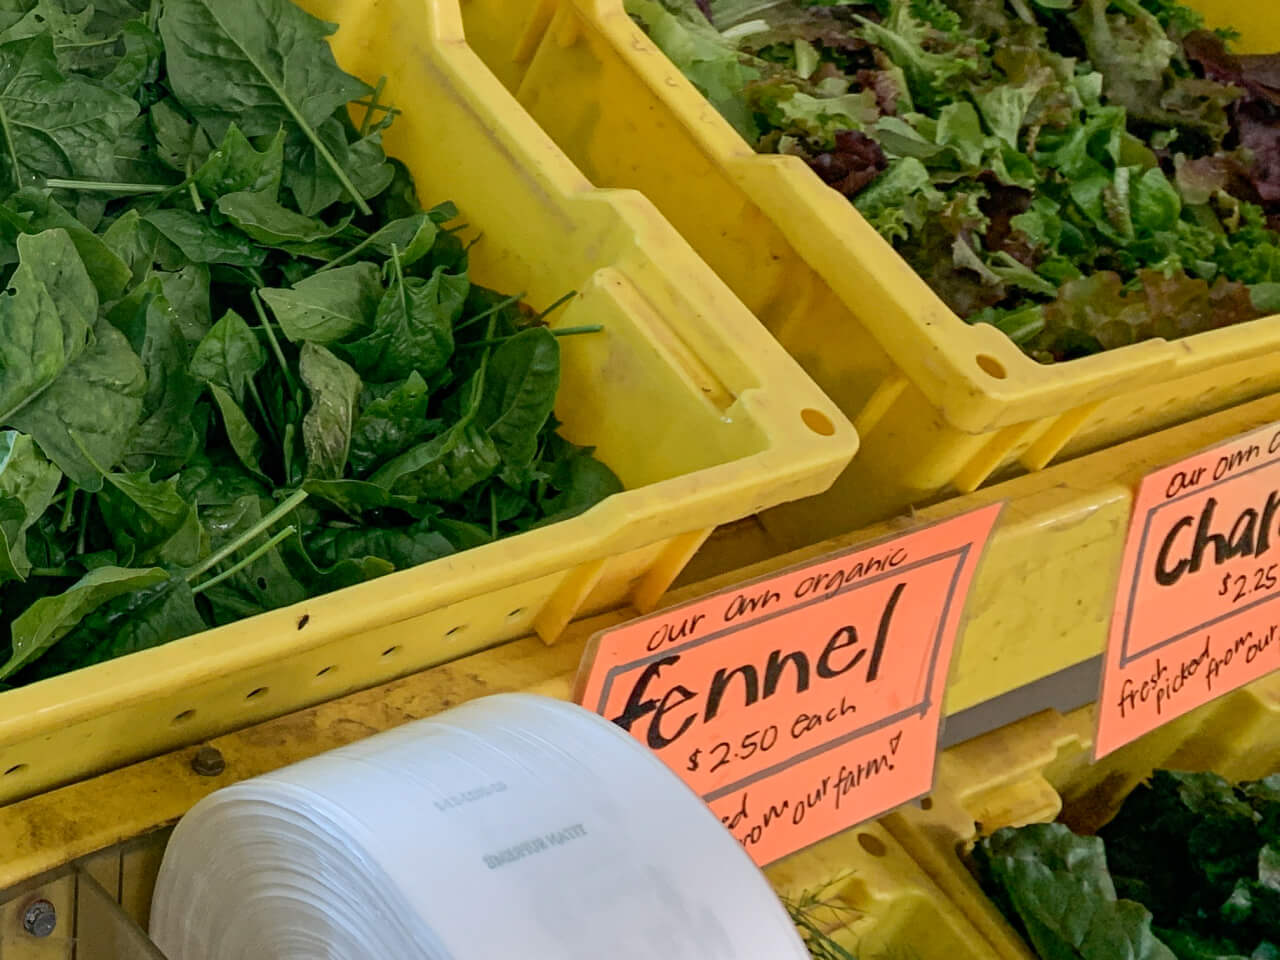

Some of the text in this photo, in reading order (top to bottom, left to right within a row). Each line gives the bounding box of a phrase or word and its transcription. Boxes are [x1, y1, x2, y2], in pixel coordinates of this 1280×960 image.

[794, 546, 908, 600] organic
[1154, 490, 1280, 587] Char
[1218, 564, 1278, 603] $2.25
[1117, 625, 1278, 718] fresh picked from our
[687, 696, 857, 774] $2.50 each
[734, 799, 789, 848] rom
[792, 769, 831, 825] our
[833, 730, 903, 810] farm!
